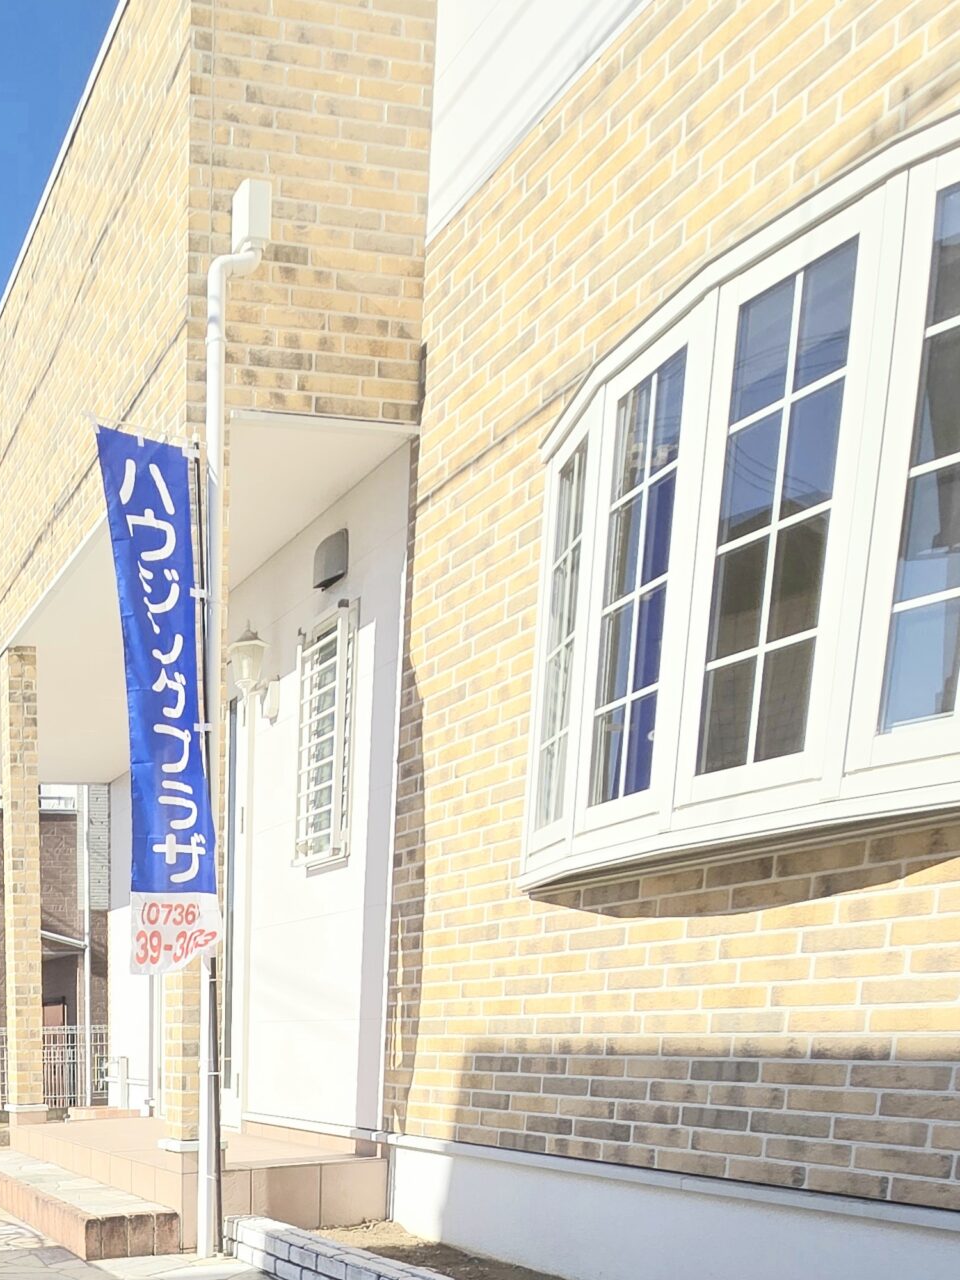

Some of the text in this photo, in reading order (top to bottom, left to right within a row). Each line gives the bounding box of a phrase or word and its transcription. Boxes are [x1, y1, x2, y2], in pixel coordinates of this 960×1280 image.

[119, 458, 206, 883] ハウジングプラザ
[141, 902, 200, 926] (0736)
